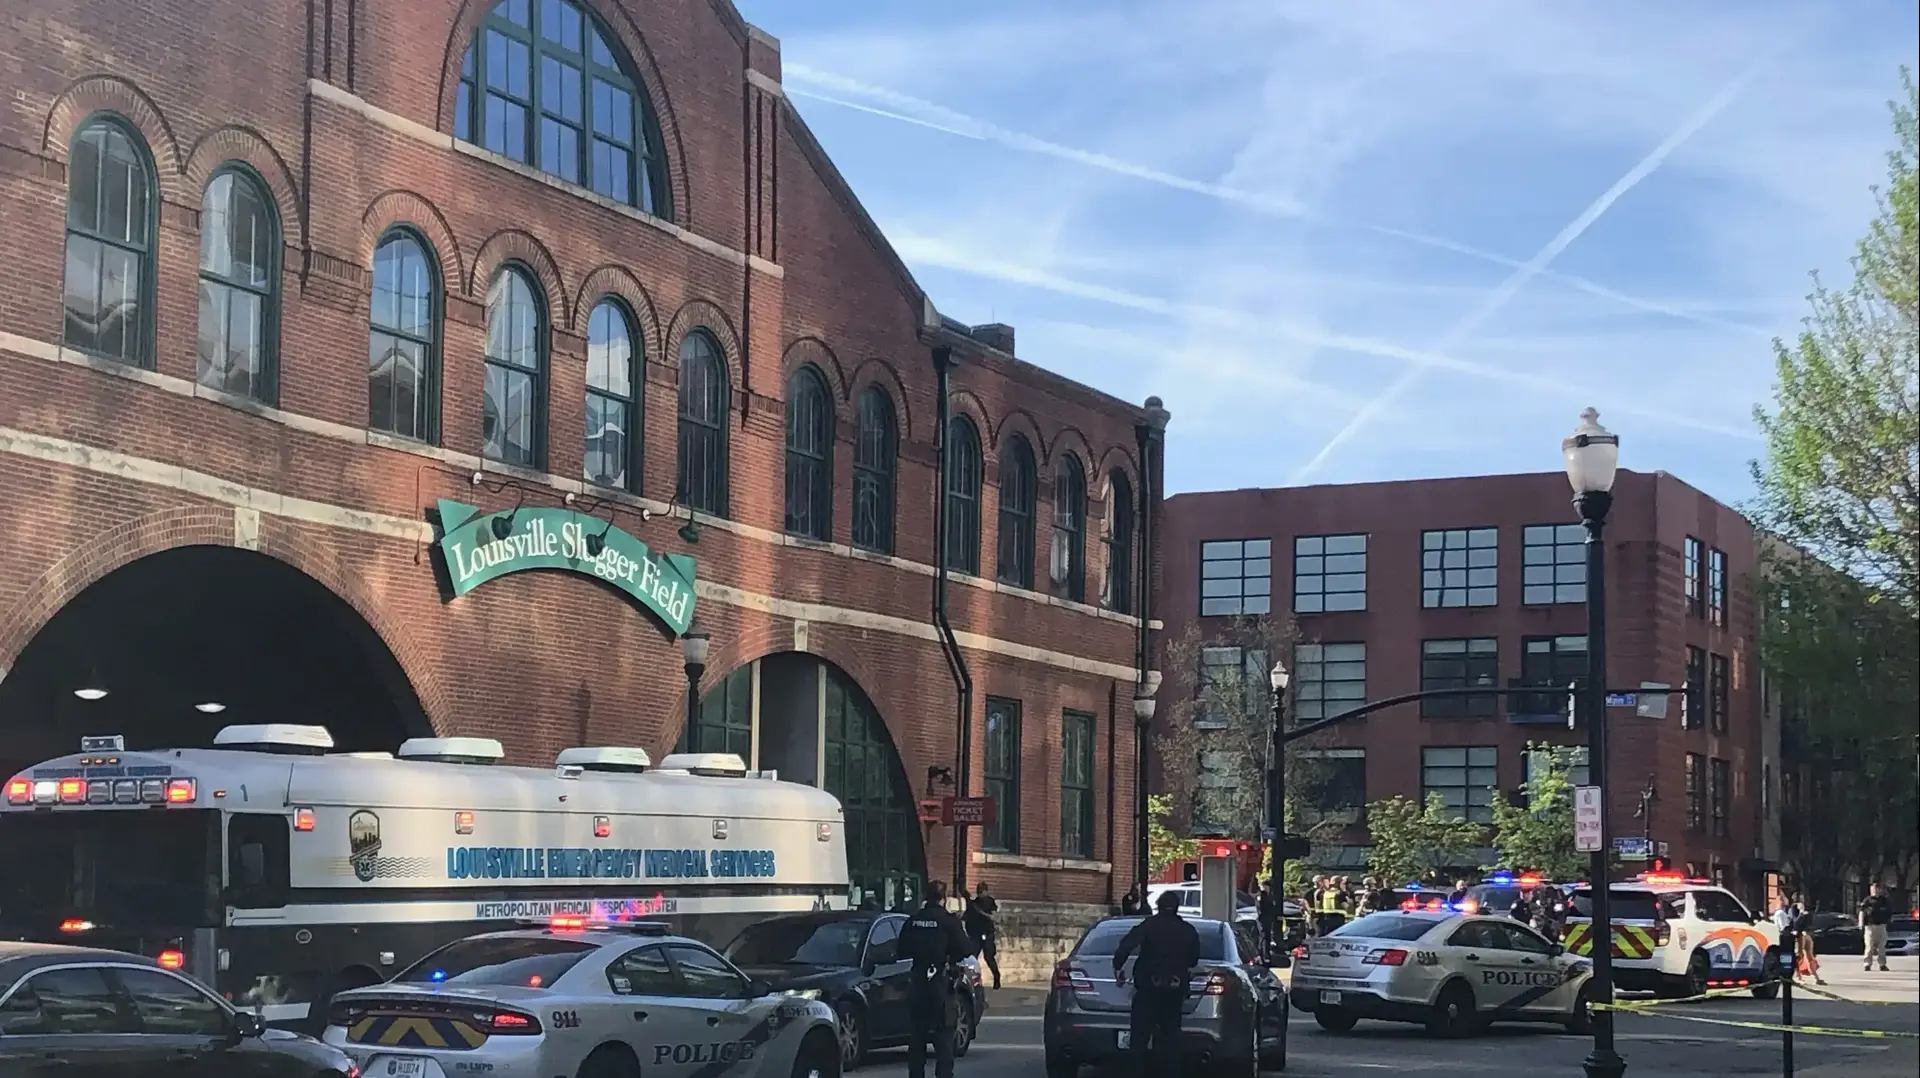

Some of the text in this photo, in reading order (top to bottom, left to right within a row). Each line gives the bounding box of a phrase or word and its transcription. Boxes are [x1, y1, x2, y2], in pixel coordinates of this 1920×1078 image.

[451, 518, 558, 583] Louisville
[639, 556, 688, 624] Field
[953, 807, 984, 815] TICKET
[447, 847, 776, 879] LOUISVILLE EMERGENCY MEDICAL SERVICES
[476, 902, 551, 917] METROPOLITAN
[554, 901, 592, 916] MEDICAL
[1340, 943, 1370, 952] POLICE
[1416, 950, 1438, 966] 911
[1482, 970, 1558, 987] POLICE
[552, 1010, 580, 1029] 911
[653, 1040, 755, 1065] POLICE
